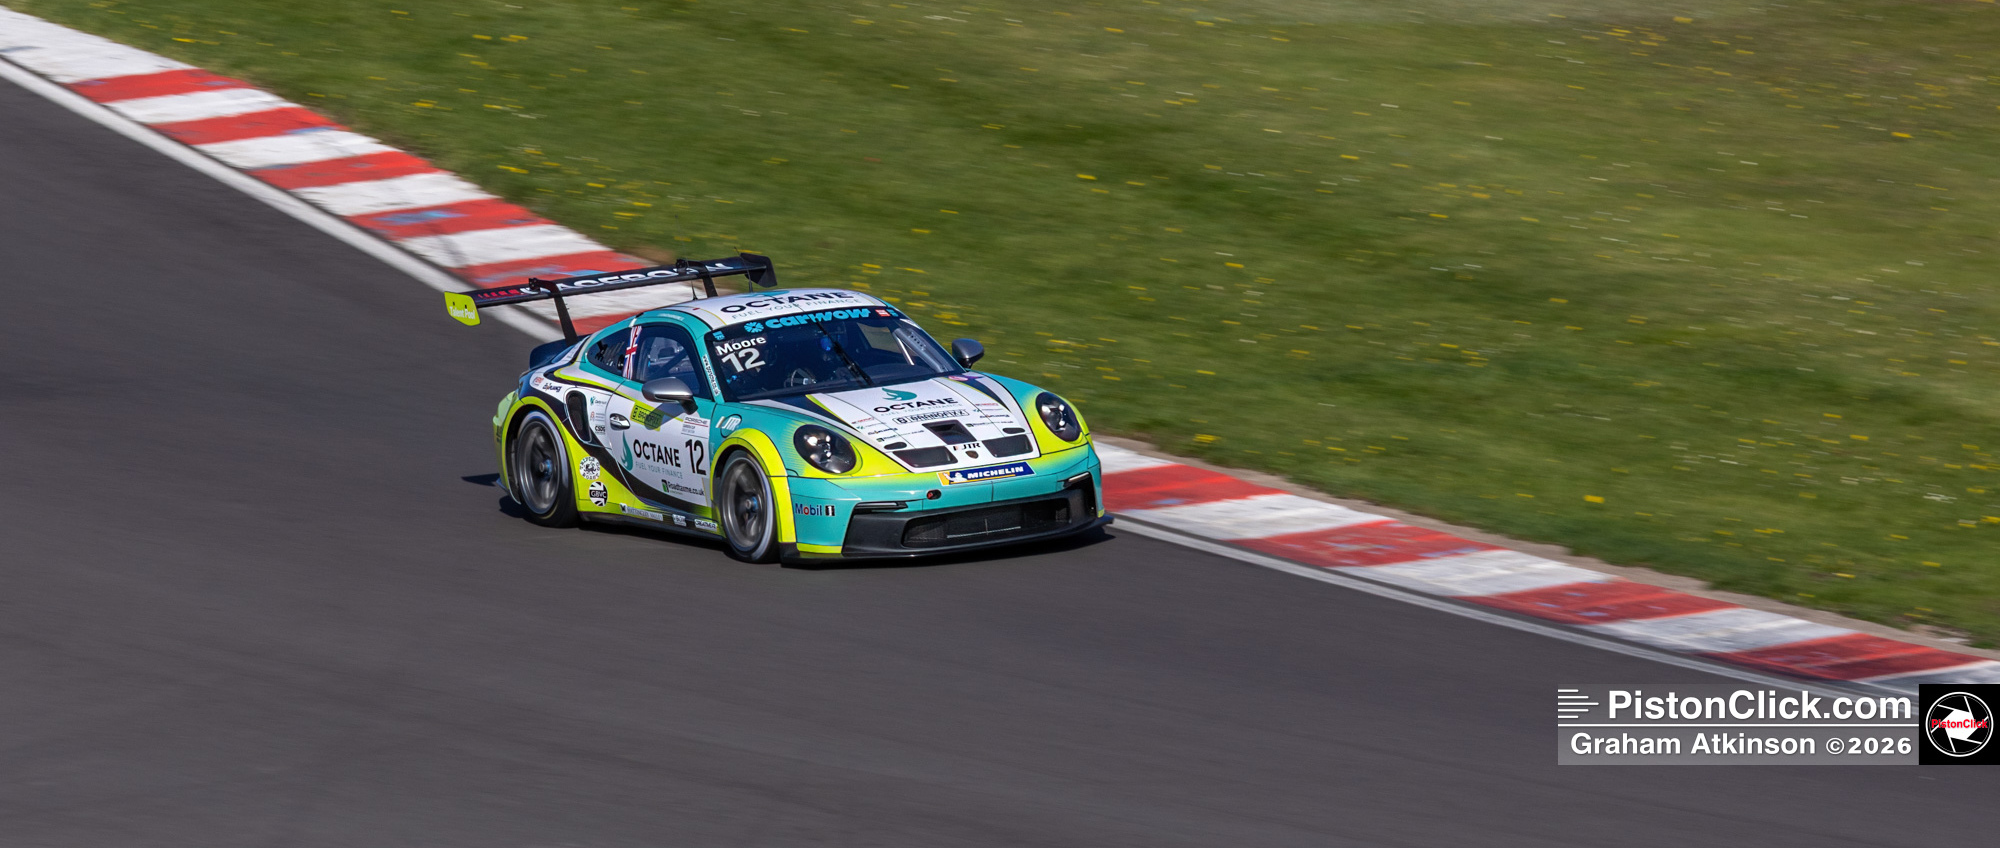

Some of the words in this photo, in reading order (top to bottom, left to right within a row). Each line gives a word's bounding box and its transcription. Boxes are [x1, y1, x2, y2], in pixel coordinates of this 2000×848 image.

[720, 291, 854, 314] OCTANE
[731, 309, 762, 319] FUEL
[767, 303, 800, 313] YOUR
[805, 298, 862, 307] FINANCE
[450, 306, 464, 318] Talent
[464, 308, 476, 319] Pool
[765, 308, 871, 328] carwow
[715, 336, 767, 355] Moore
[721, 347, 766, 373] 12
[873, 397, 958, 413] OCTANE
[633, 439, 681, 468] OCTANE
[685, 439, 707, 475] 12
[635, 461, 647, 470] FUEL
[648, 464, 661, 473] YOUR
[661, 468, 683, 479] FINANCE
[967, 466, 1024, 480] MICHELIN
[591, 490, 607, 499] GBVC
[795, 503, 823, 516] Mobil
